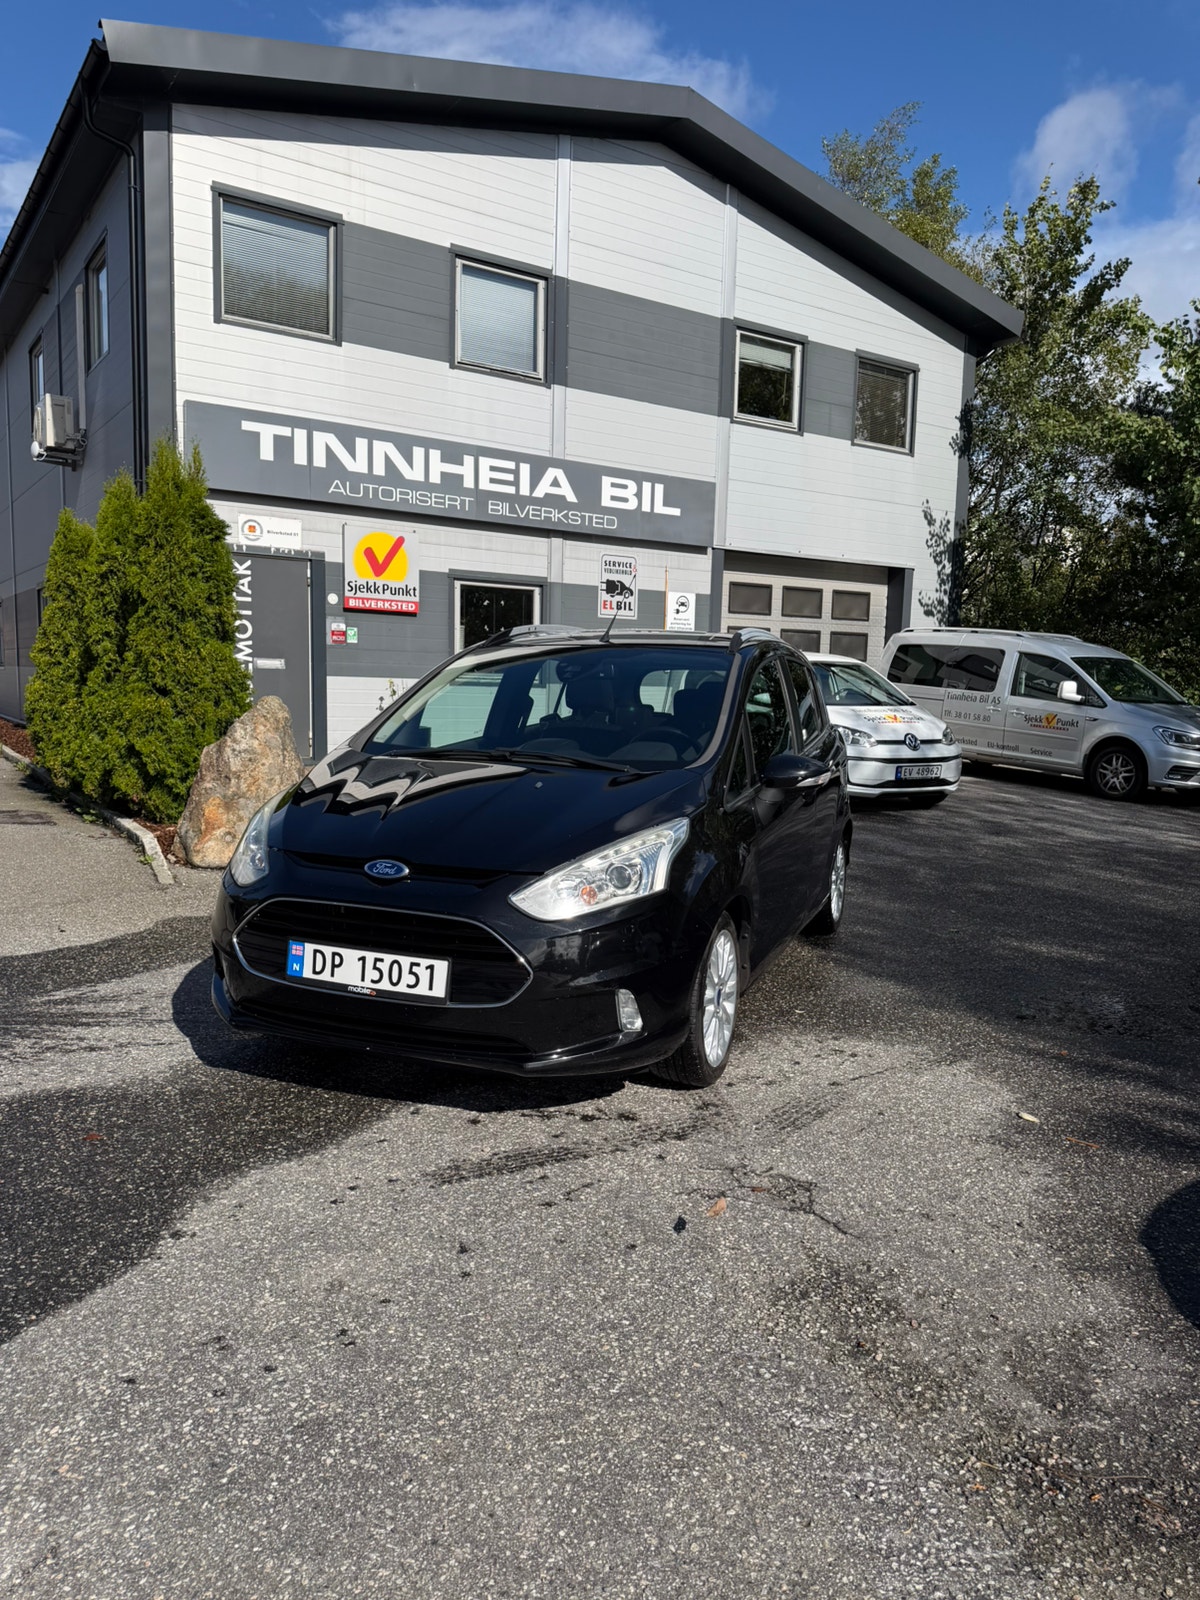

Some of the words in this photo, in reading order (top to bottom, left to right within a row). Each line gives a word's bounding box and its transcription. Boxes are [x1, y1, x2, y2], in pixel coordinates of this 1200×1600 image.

[241, 420, 578, 503] TINNHEIA
[601, 475, 681, 517] BIL
[328, 479, 474, 511] AUTORISERT
[488, 500, 618, 530] BILVERKSTED
[604, 560, 633, 569] SERVICE
[348, 598, 416, 611] BILVERKSTED
[946, 692, 977, 703] Tinnheia
[979, 695, 989, 704] Bil
[990, 696, 1001, 705] AS
[954, 711, 962, 719] 38
[1024, 714, 1043, 724] Sjekk
[1056, 717, 1079, 728] Punkt
[987, 741, 1019, 752] EU-kontroll
[1030, 747, 1052, 757] Service
[903, 767, 914, 776] EV
[916, 766, 940, 776] 48962
[373, 862, 398, 875] Ford
[292, 963, 300, 971] N
[312, 948, 344, 978] DP
[357, 955, 435, 991] 15051
